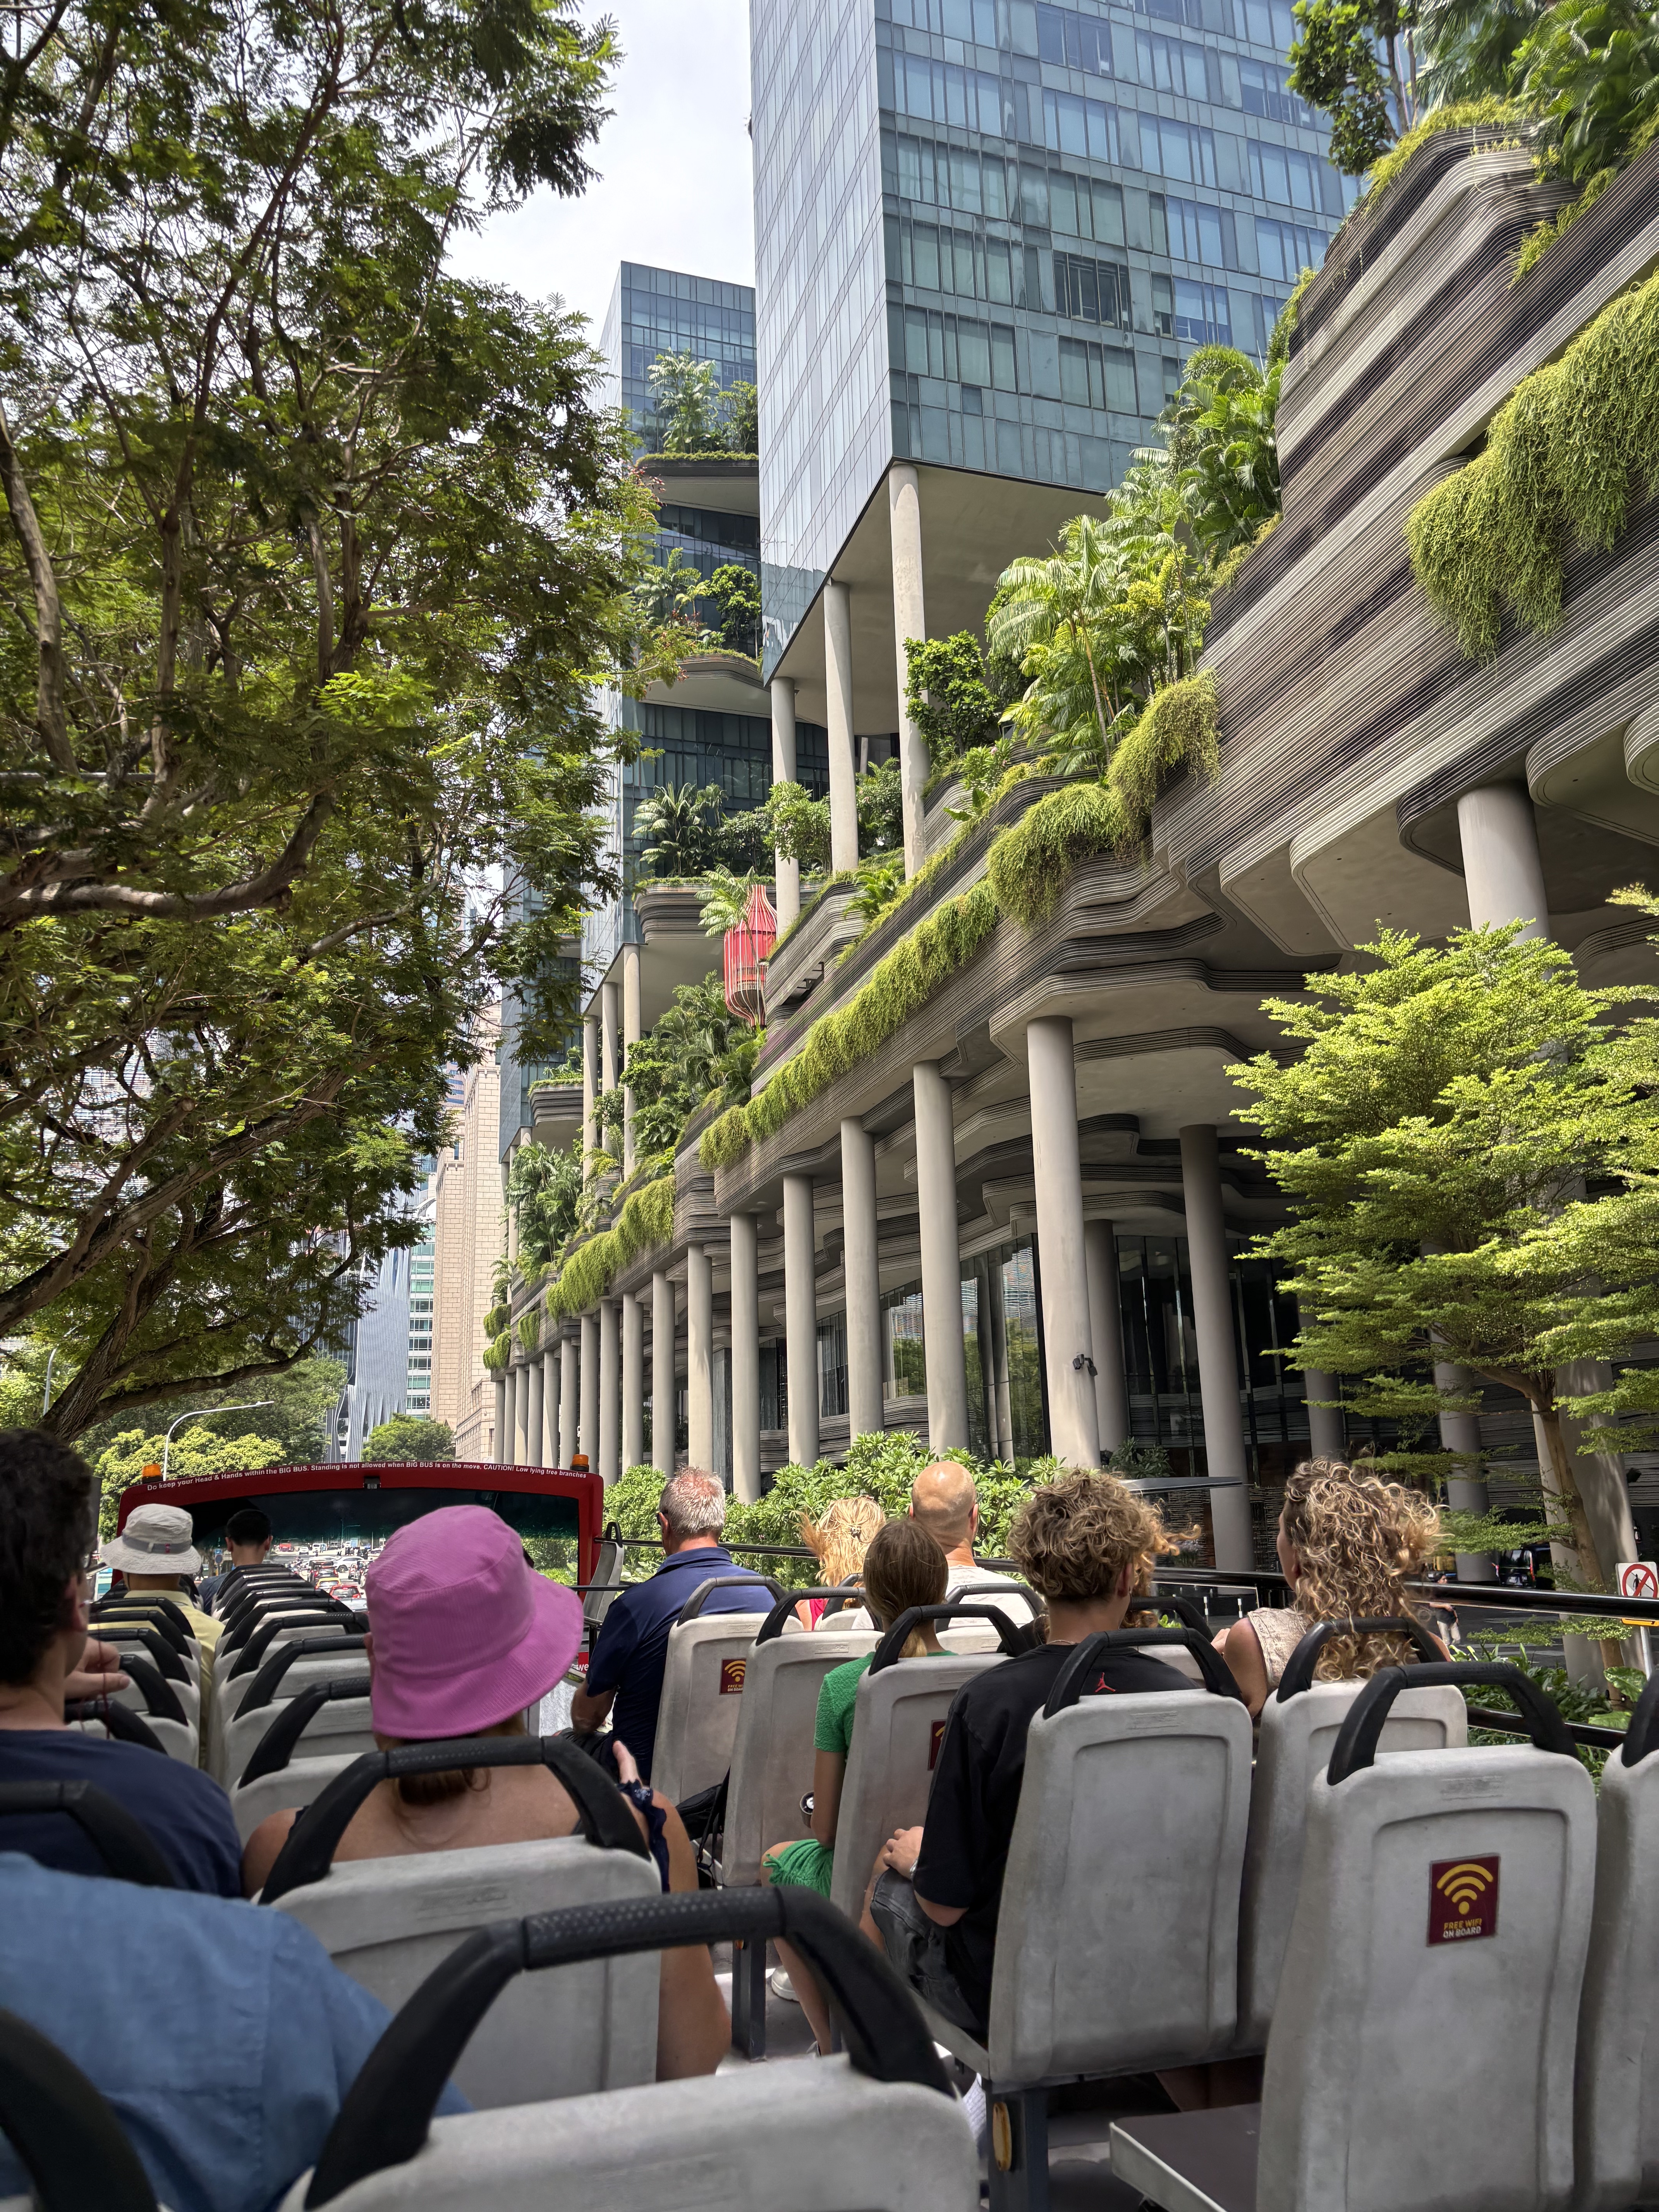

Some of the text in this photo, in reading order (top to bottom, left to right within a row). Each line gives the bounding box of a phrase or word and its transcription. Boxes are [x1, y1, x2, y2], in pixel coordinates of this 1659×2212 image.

[177, 1479, 193, 1487] your
[559, 1470, 586, 1478] branches
[1444, 1921, 1463, 1930] FREE
[1443, 1926, 1481, 1939] ON BOARD
